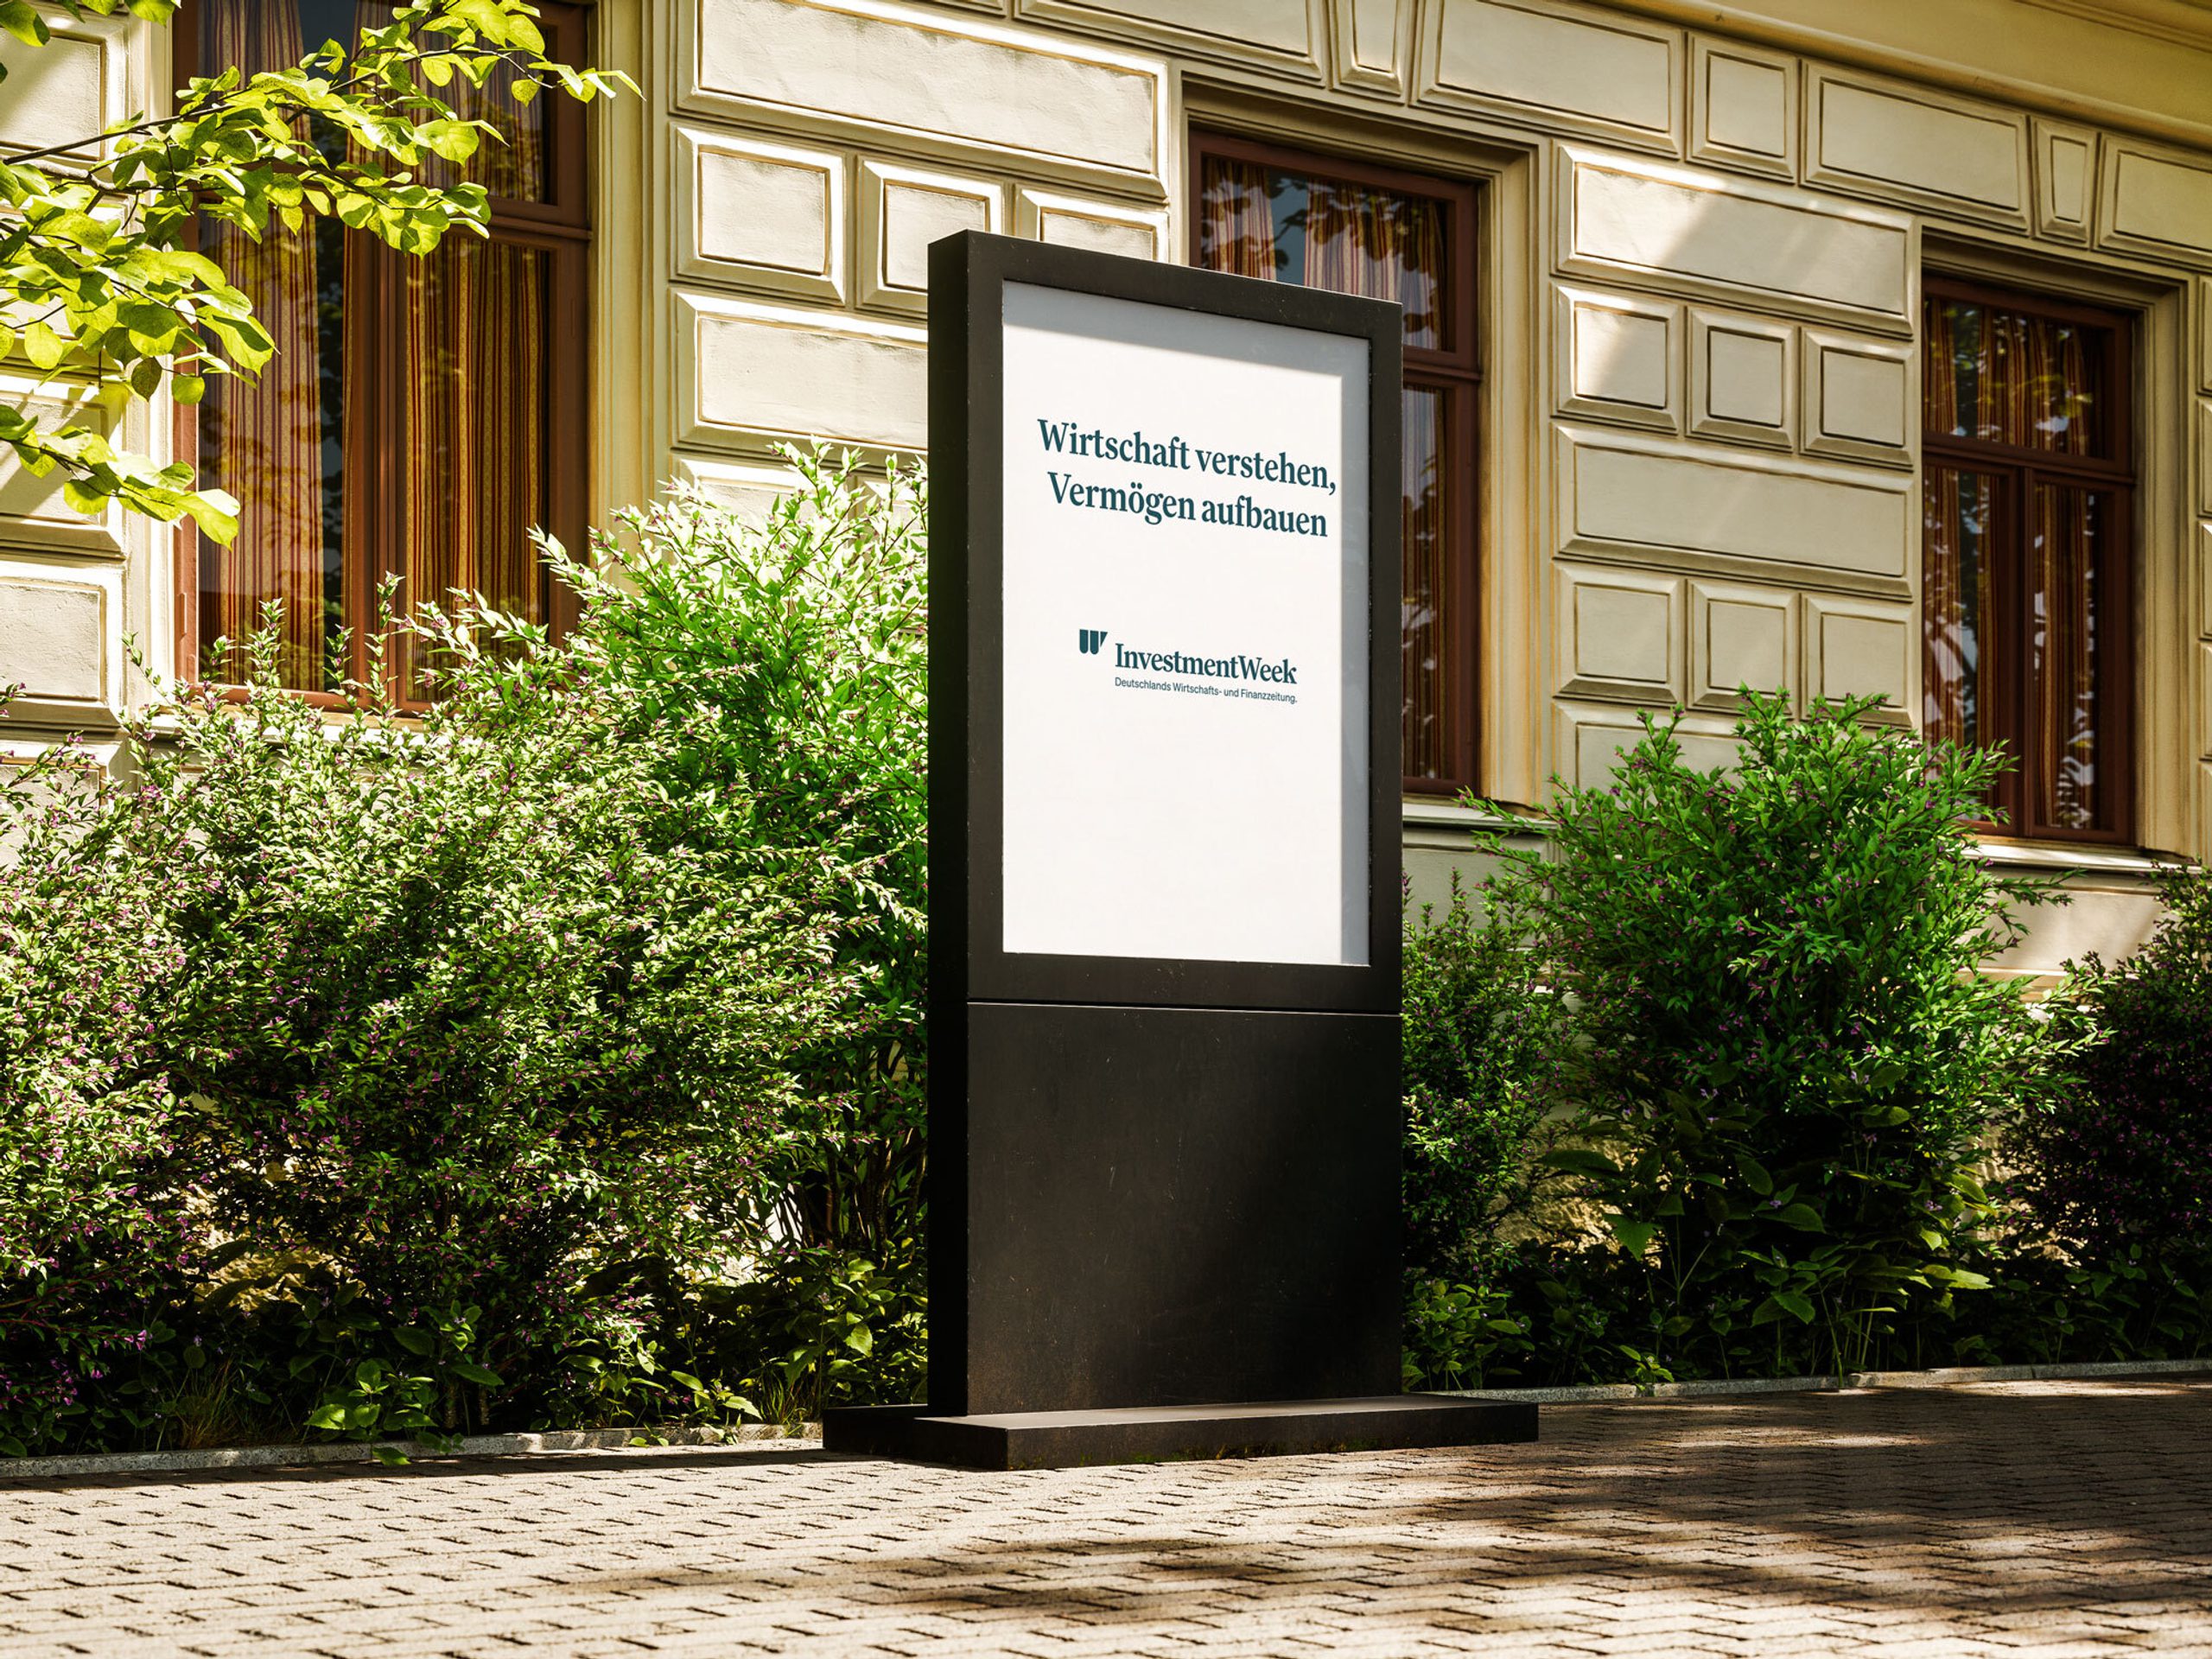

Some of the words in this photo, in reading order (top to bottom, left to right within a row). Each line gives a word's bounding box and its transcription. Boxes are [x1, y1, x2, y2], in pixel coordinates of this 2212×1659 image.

[1036, 418, 1192, 470] Wirtschaft
[1194, 448, 1337, 496] verstehen,
[1046, 471, 1197, 525] Vermögen
[1201, 494, 1328, 537] aufbauen
[1115, 642, 1298, 685] InvestmentWeek
[1115, 677, 1172, 691] Deutschlands
[1172, 682, 1223, 696] Wirtschafts-
[1223, 688, 1239, 698] und
[1240, 688, 1298, 704] Finanzzeitung.
